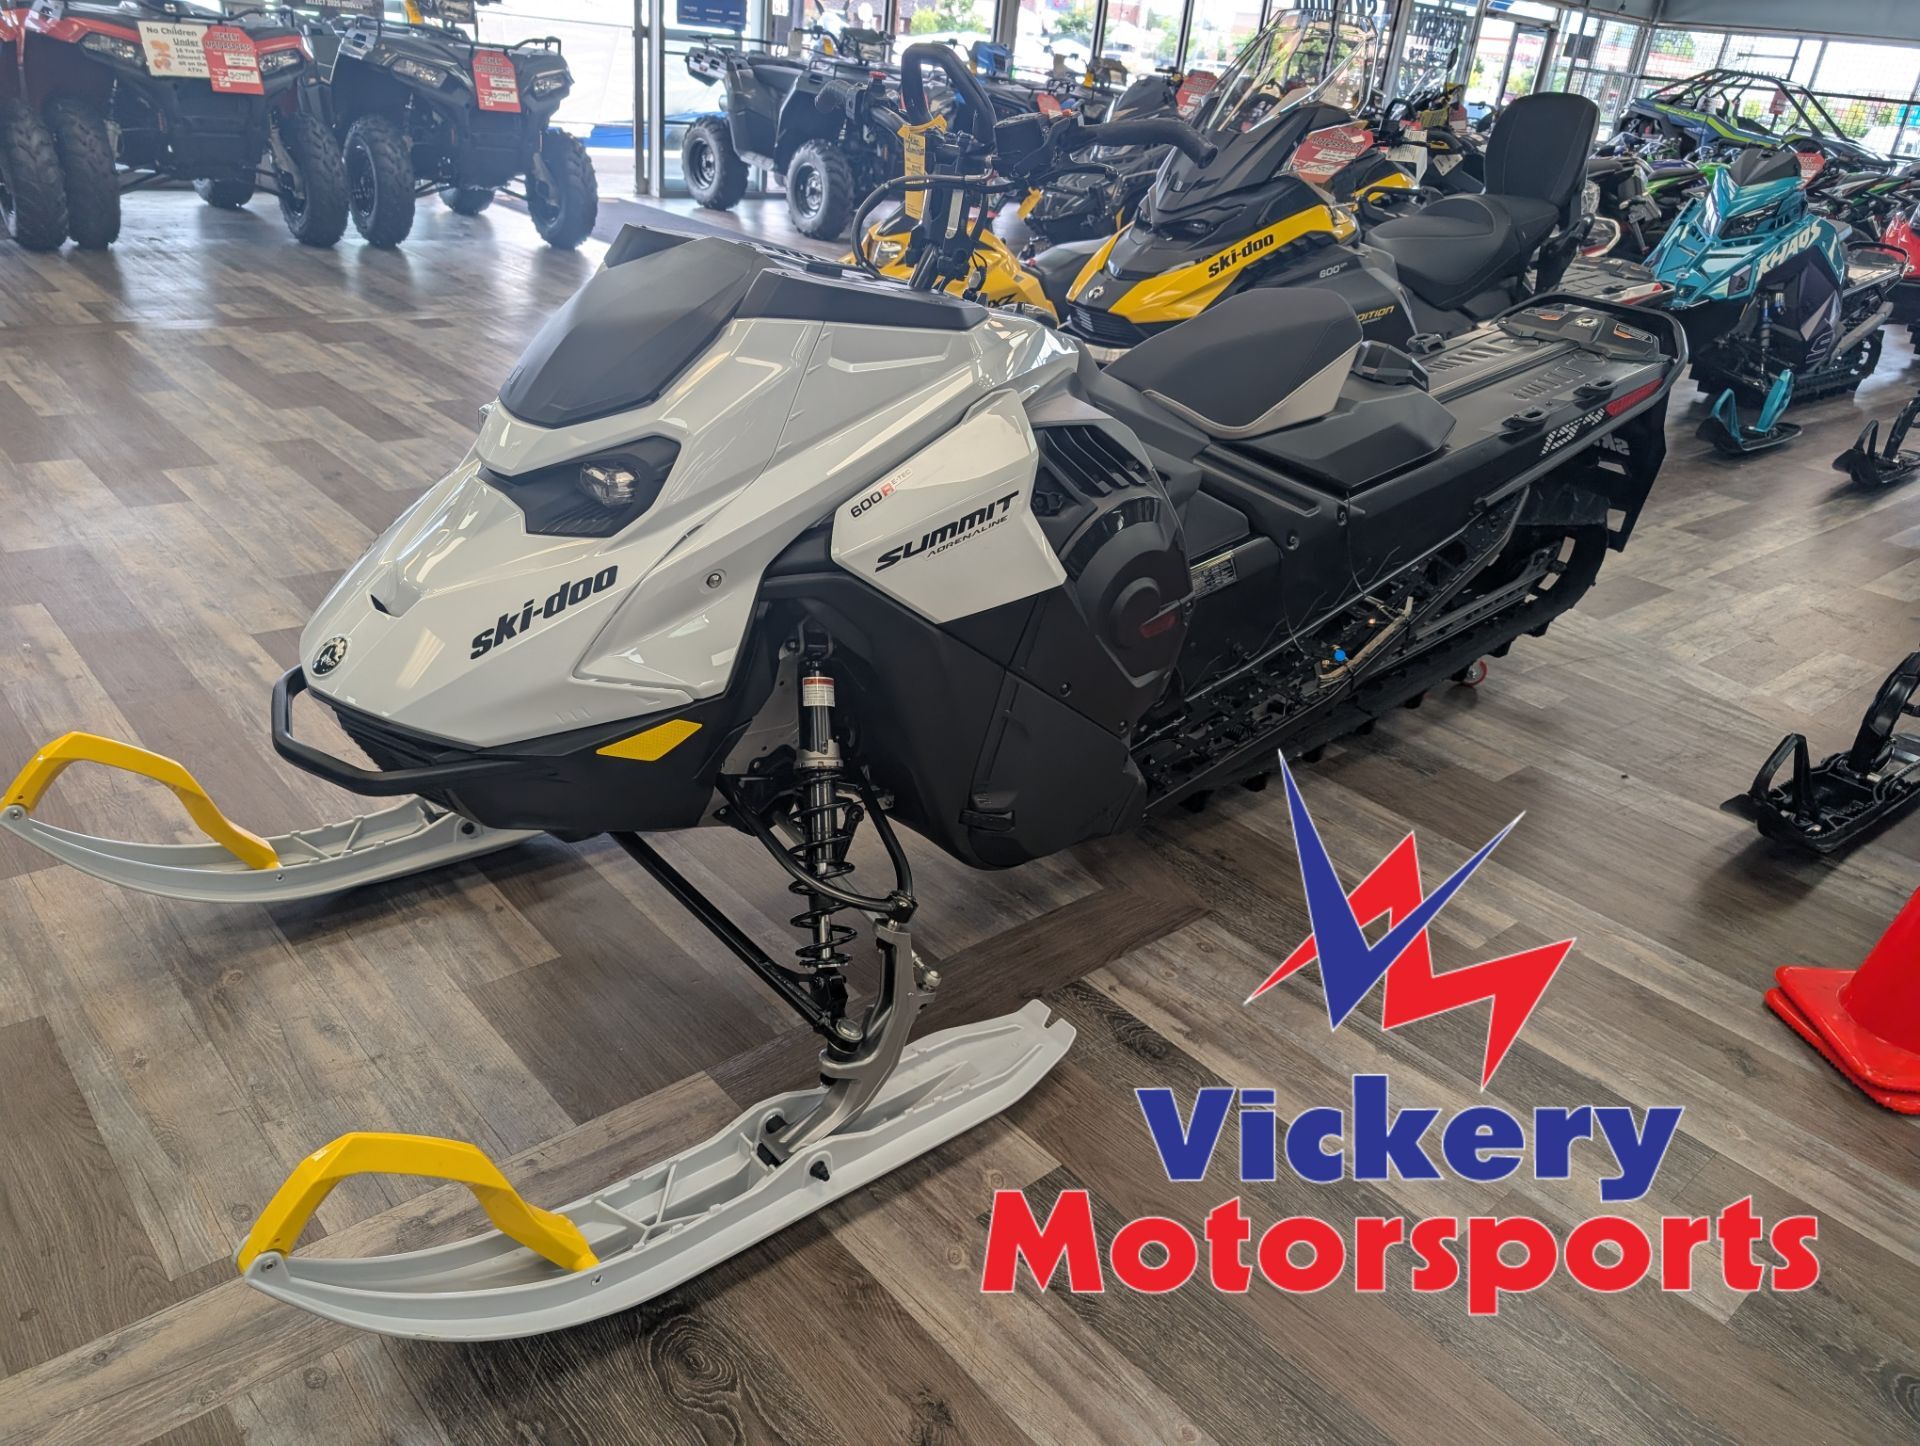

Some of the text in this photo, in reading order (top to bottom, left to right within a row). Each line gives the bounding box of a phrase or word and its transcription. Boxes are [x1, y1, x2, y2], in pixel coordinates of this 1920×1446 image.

[146, 26, 197, 37] No Children
[173, 38, 199, 47] Under
[1755, 218, 1822, 284] KHAOS
[874, 490, 1020, 574] SUMMIT
[926, 515, 1009, 559] ADRENALINE
[470, 565, 618, 660] ski-doo
